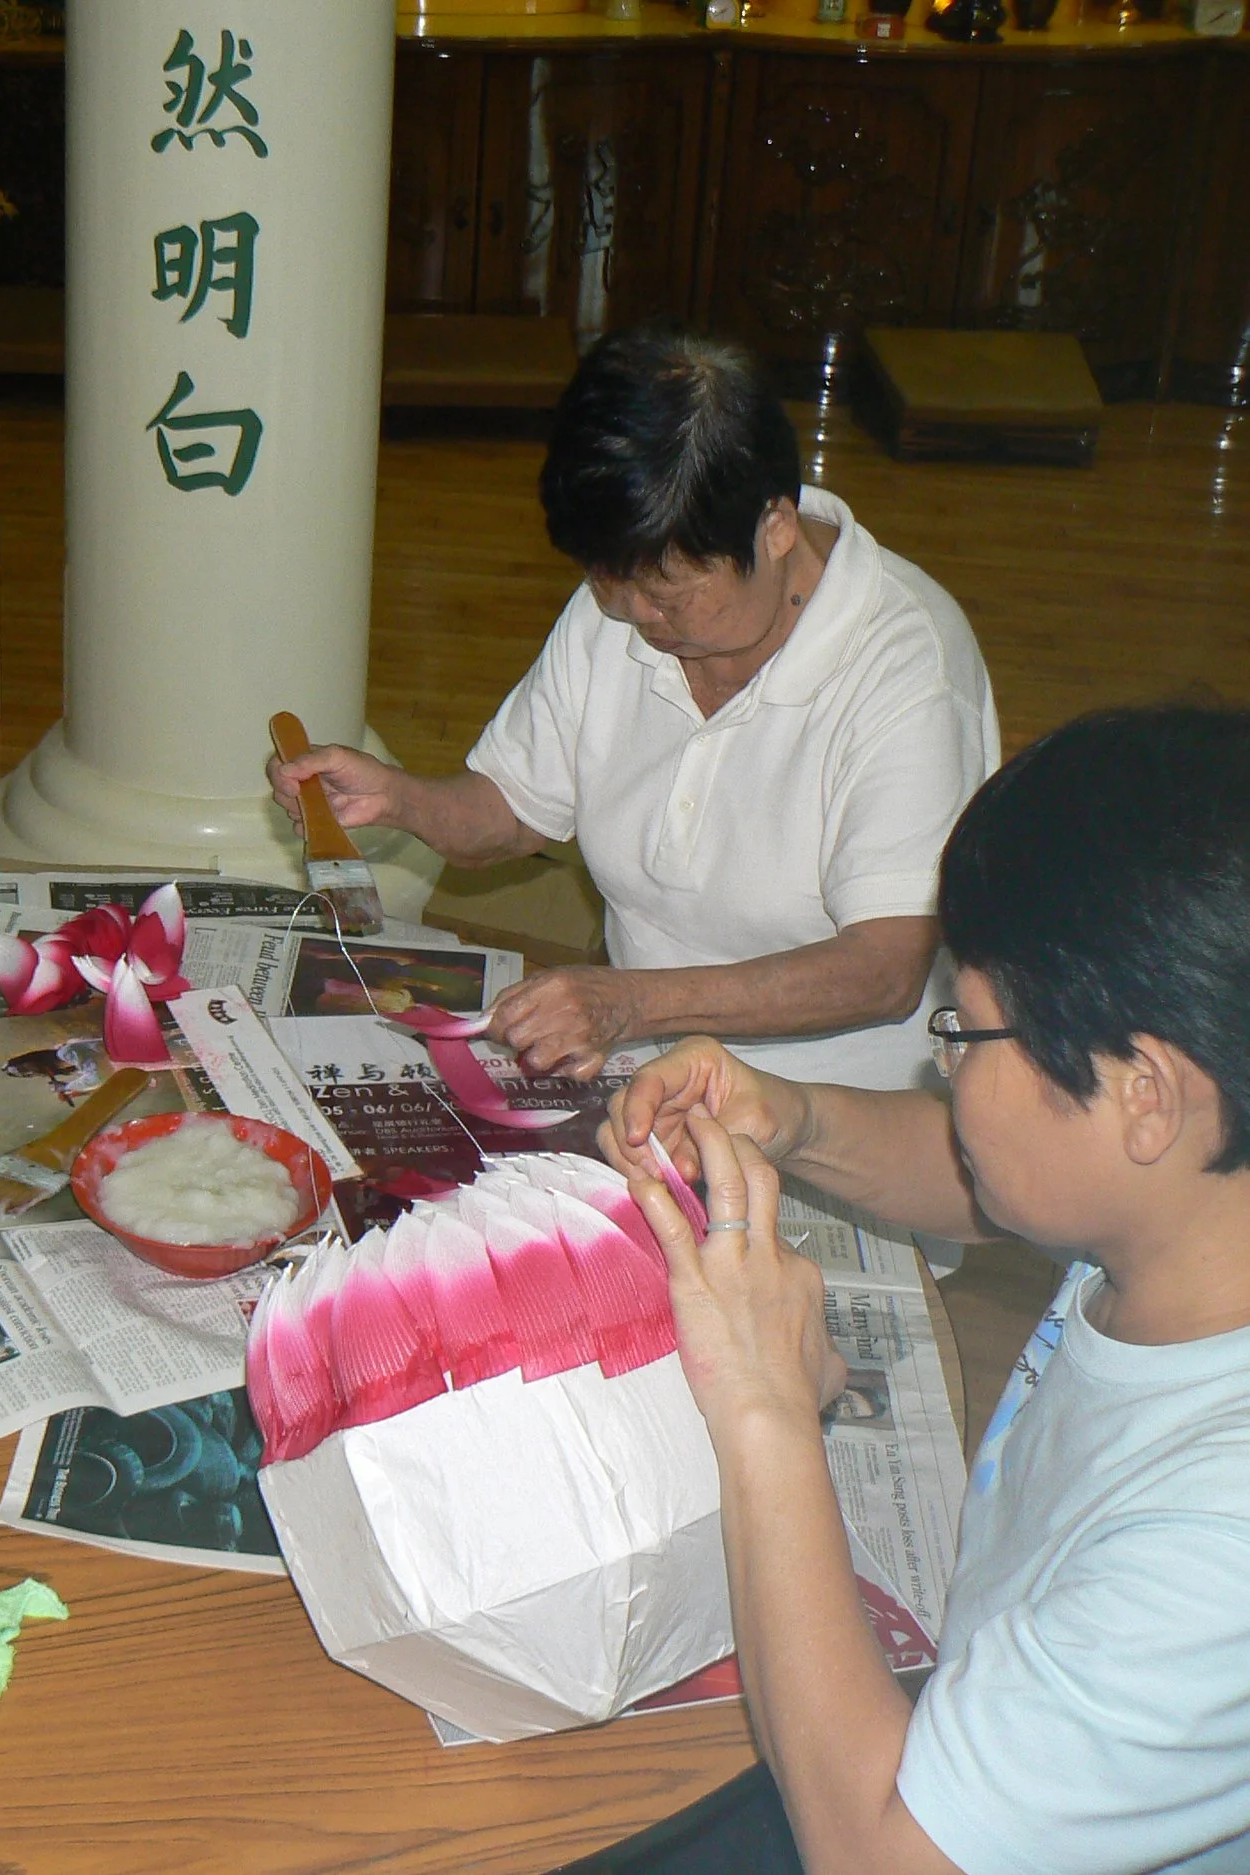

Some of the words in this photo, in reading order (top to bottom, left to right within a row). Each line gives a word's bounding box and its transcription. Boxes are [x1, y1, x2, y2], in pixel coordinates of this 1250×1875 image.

[259, 934, 284, 963] Feud
[249, 963, 277, 1005] between
[312, 1084, 374, 1099] Zen
[387, 1083, 410, 1098] &
[847, 1294, 872, 1331] Many
[890, 1476, 905, 1499] Sang
[893, 1503, 909, 1527] posts
[901, 1529, 914, 1547] loss
[905, 1550, 920, 1571] after
[911, 1575, 931, 1620] write-off
